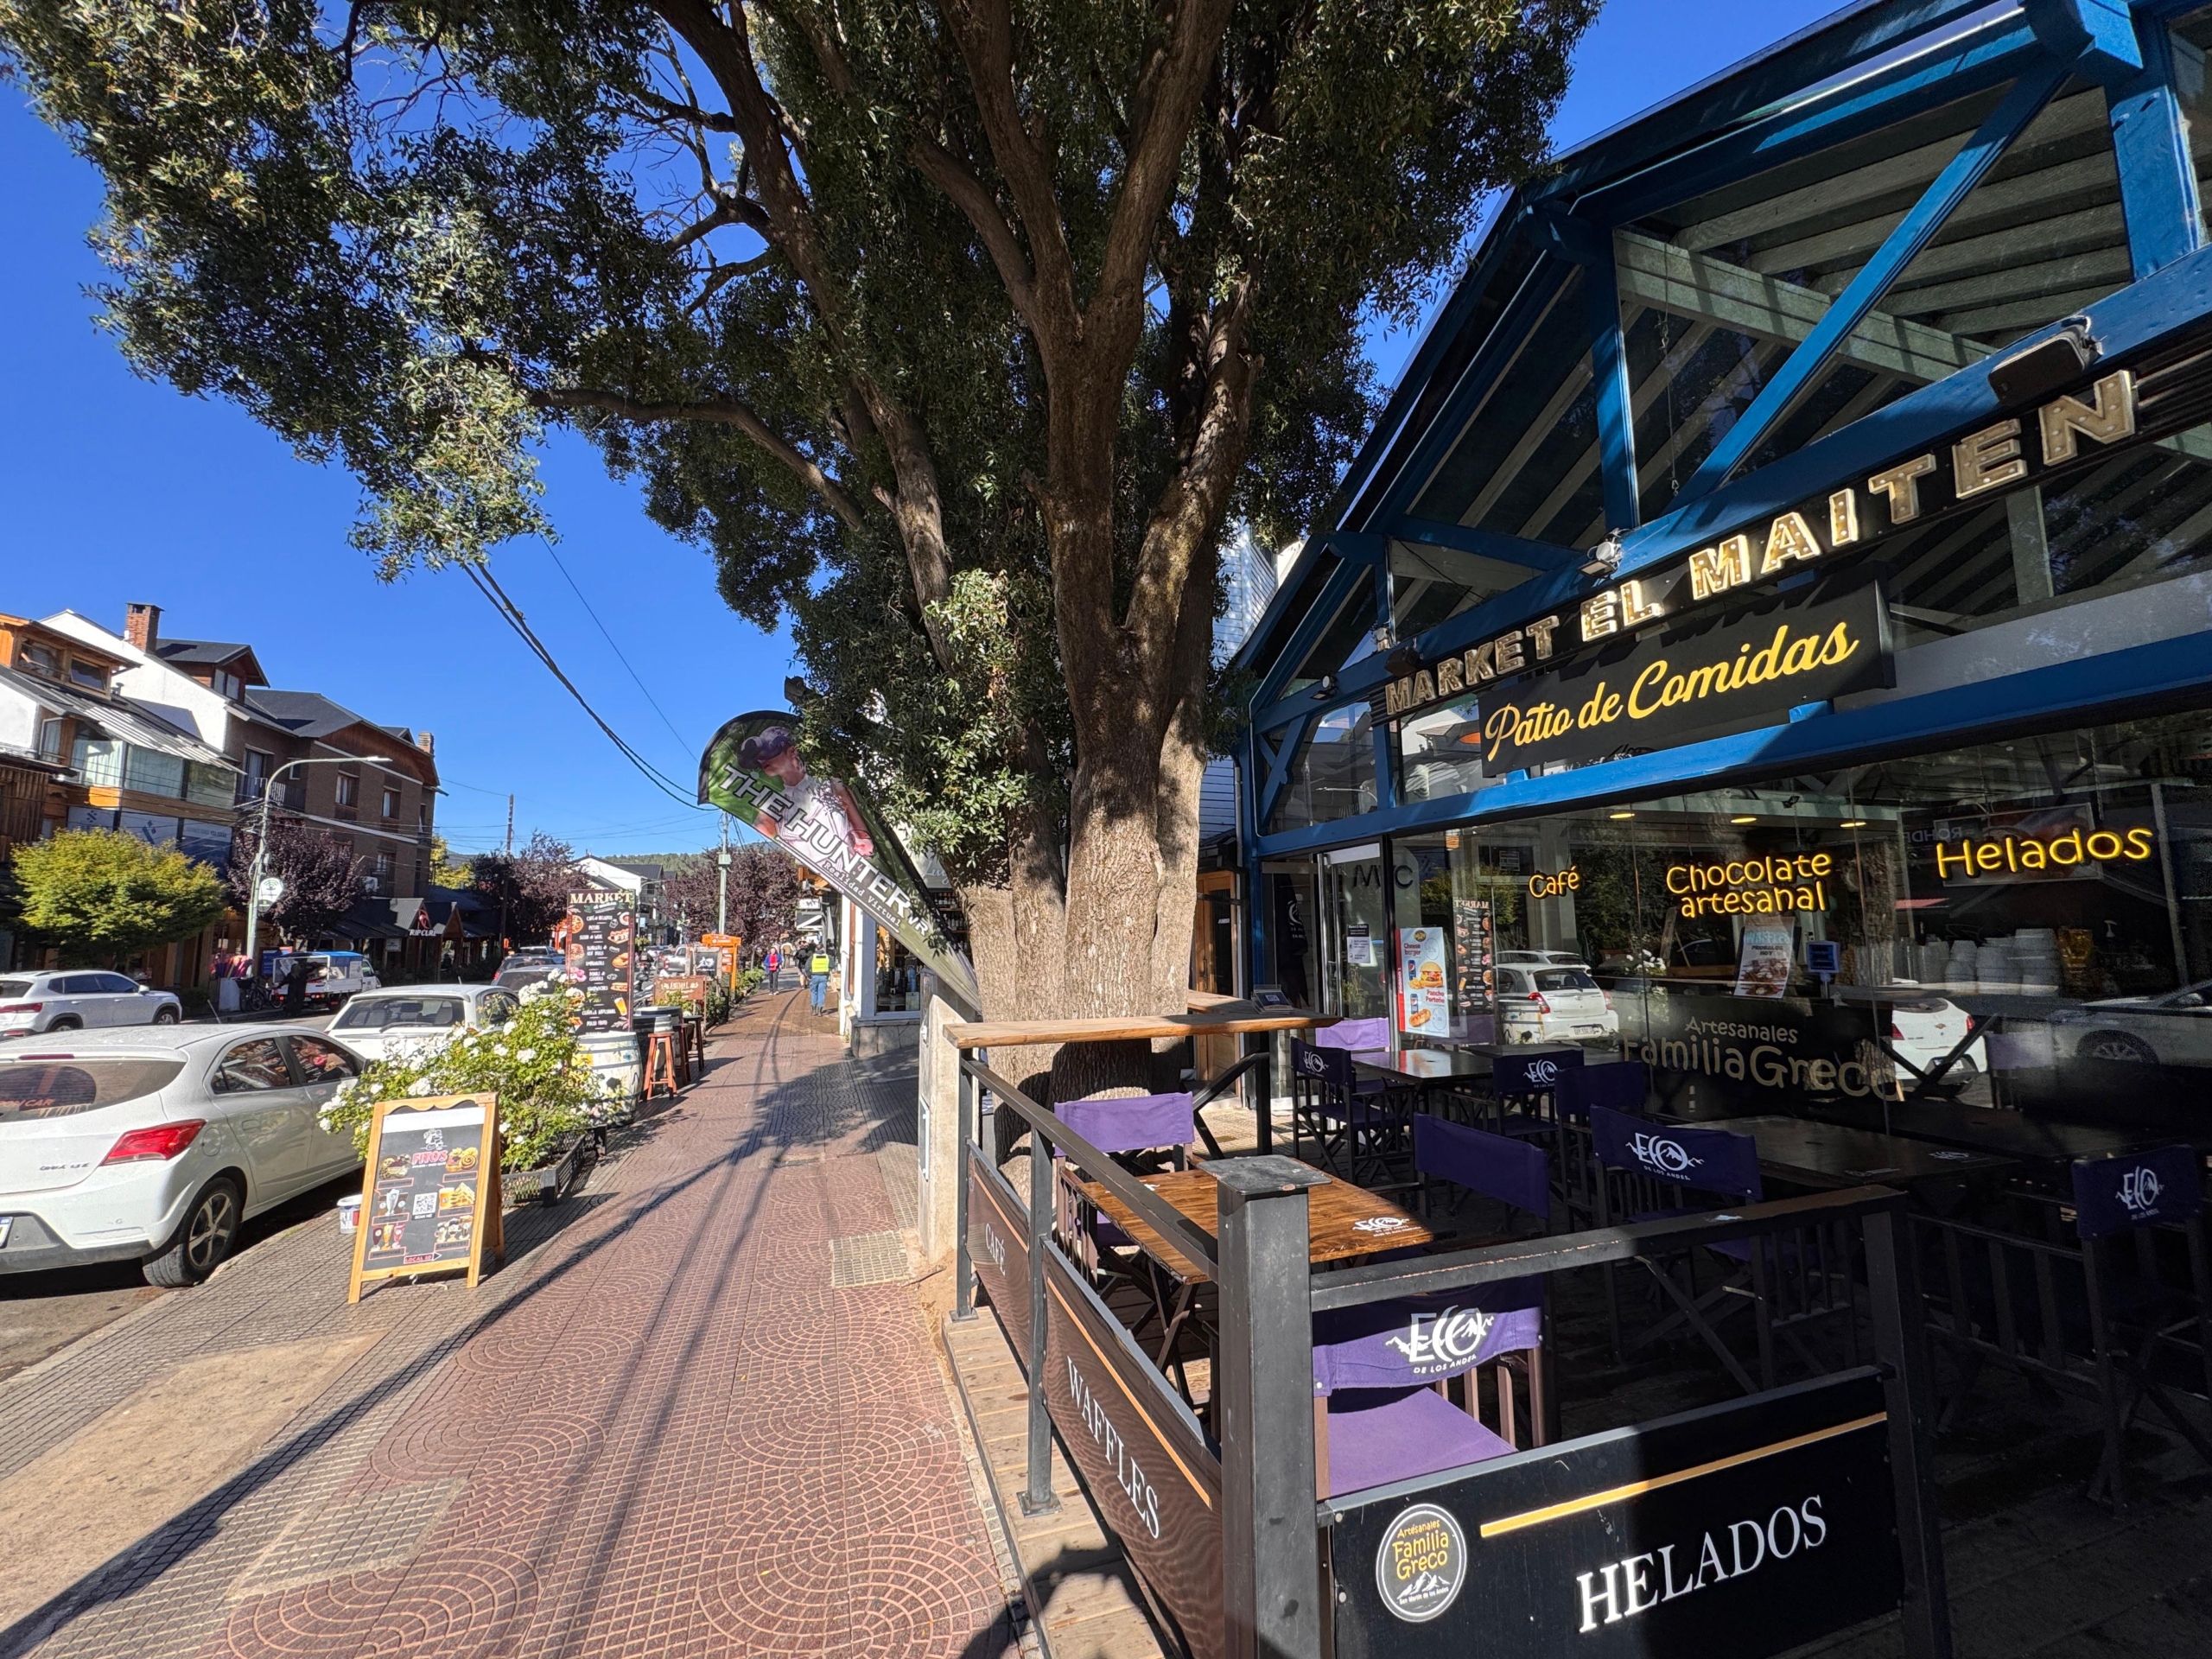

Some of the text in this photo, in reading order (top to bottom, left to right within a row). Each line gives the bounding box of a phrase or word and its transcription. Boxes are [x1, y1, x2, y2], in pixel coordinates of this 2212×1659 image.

[1384, 370, 2140, 715] MARKET EL MAITEN
[1484, 622, 1859, 762] Patio de Comidas
[719, 764, 929, 937] THE HUNTER VR
[1936, 828, 2152, 879] Helados
[823, 861, 901, 926] Realidad Virtual
[1529, 866, 1580, 898] Café
[1666, 854, 1832, 893] Chocolate
[570, 893, 632, 904] MARKET
[1681, 880, 1826, 918] artesanal
[1686, 1016, 1798, 1044] Artesanales
[1635, 1132, 1688, 1172] ECO
[2123, 1166, 2158, 1210] ECO
[986, 1223, 1006, 1276] CAFÉ
[1409, 1305, 1482, 1363] ECO
[1430, 1363, 1446, 1373] LOS
[1067, 1355, 1159, 1539] WAFFLES
[1392, 1529, 1449, 1562] Familia
[1397, 1520, 1440, 1538] Artesanales
[1396, 1550, 1448, 1580] Greco
[1575, 1495, 1827, 1634] HELADOS
